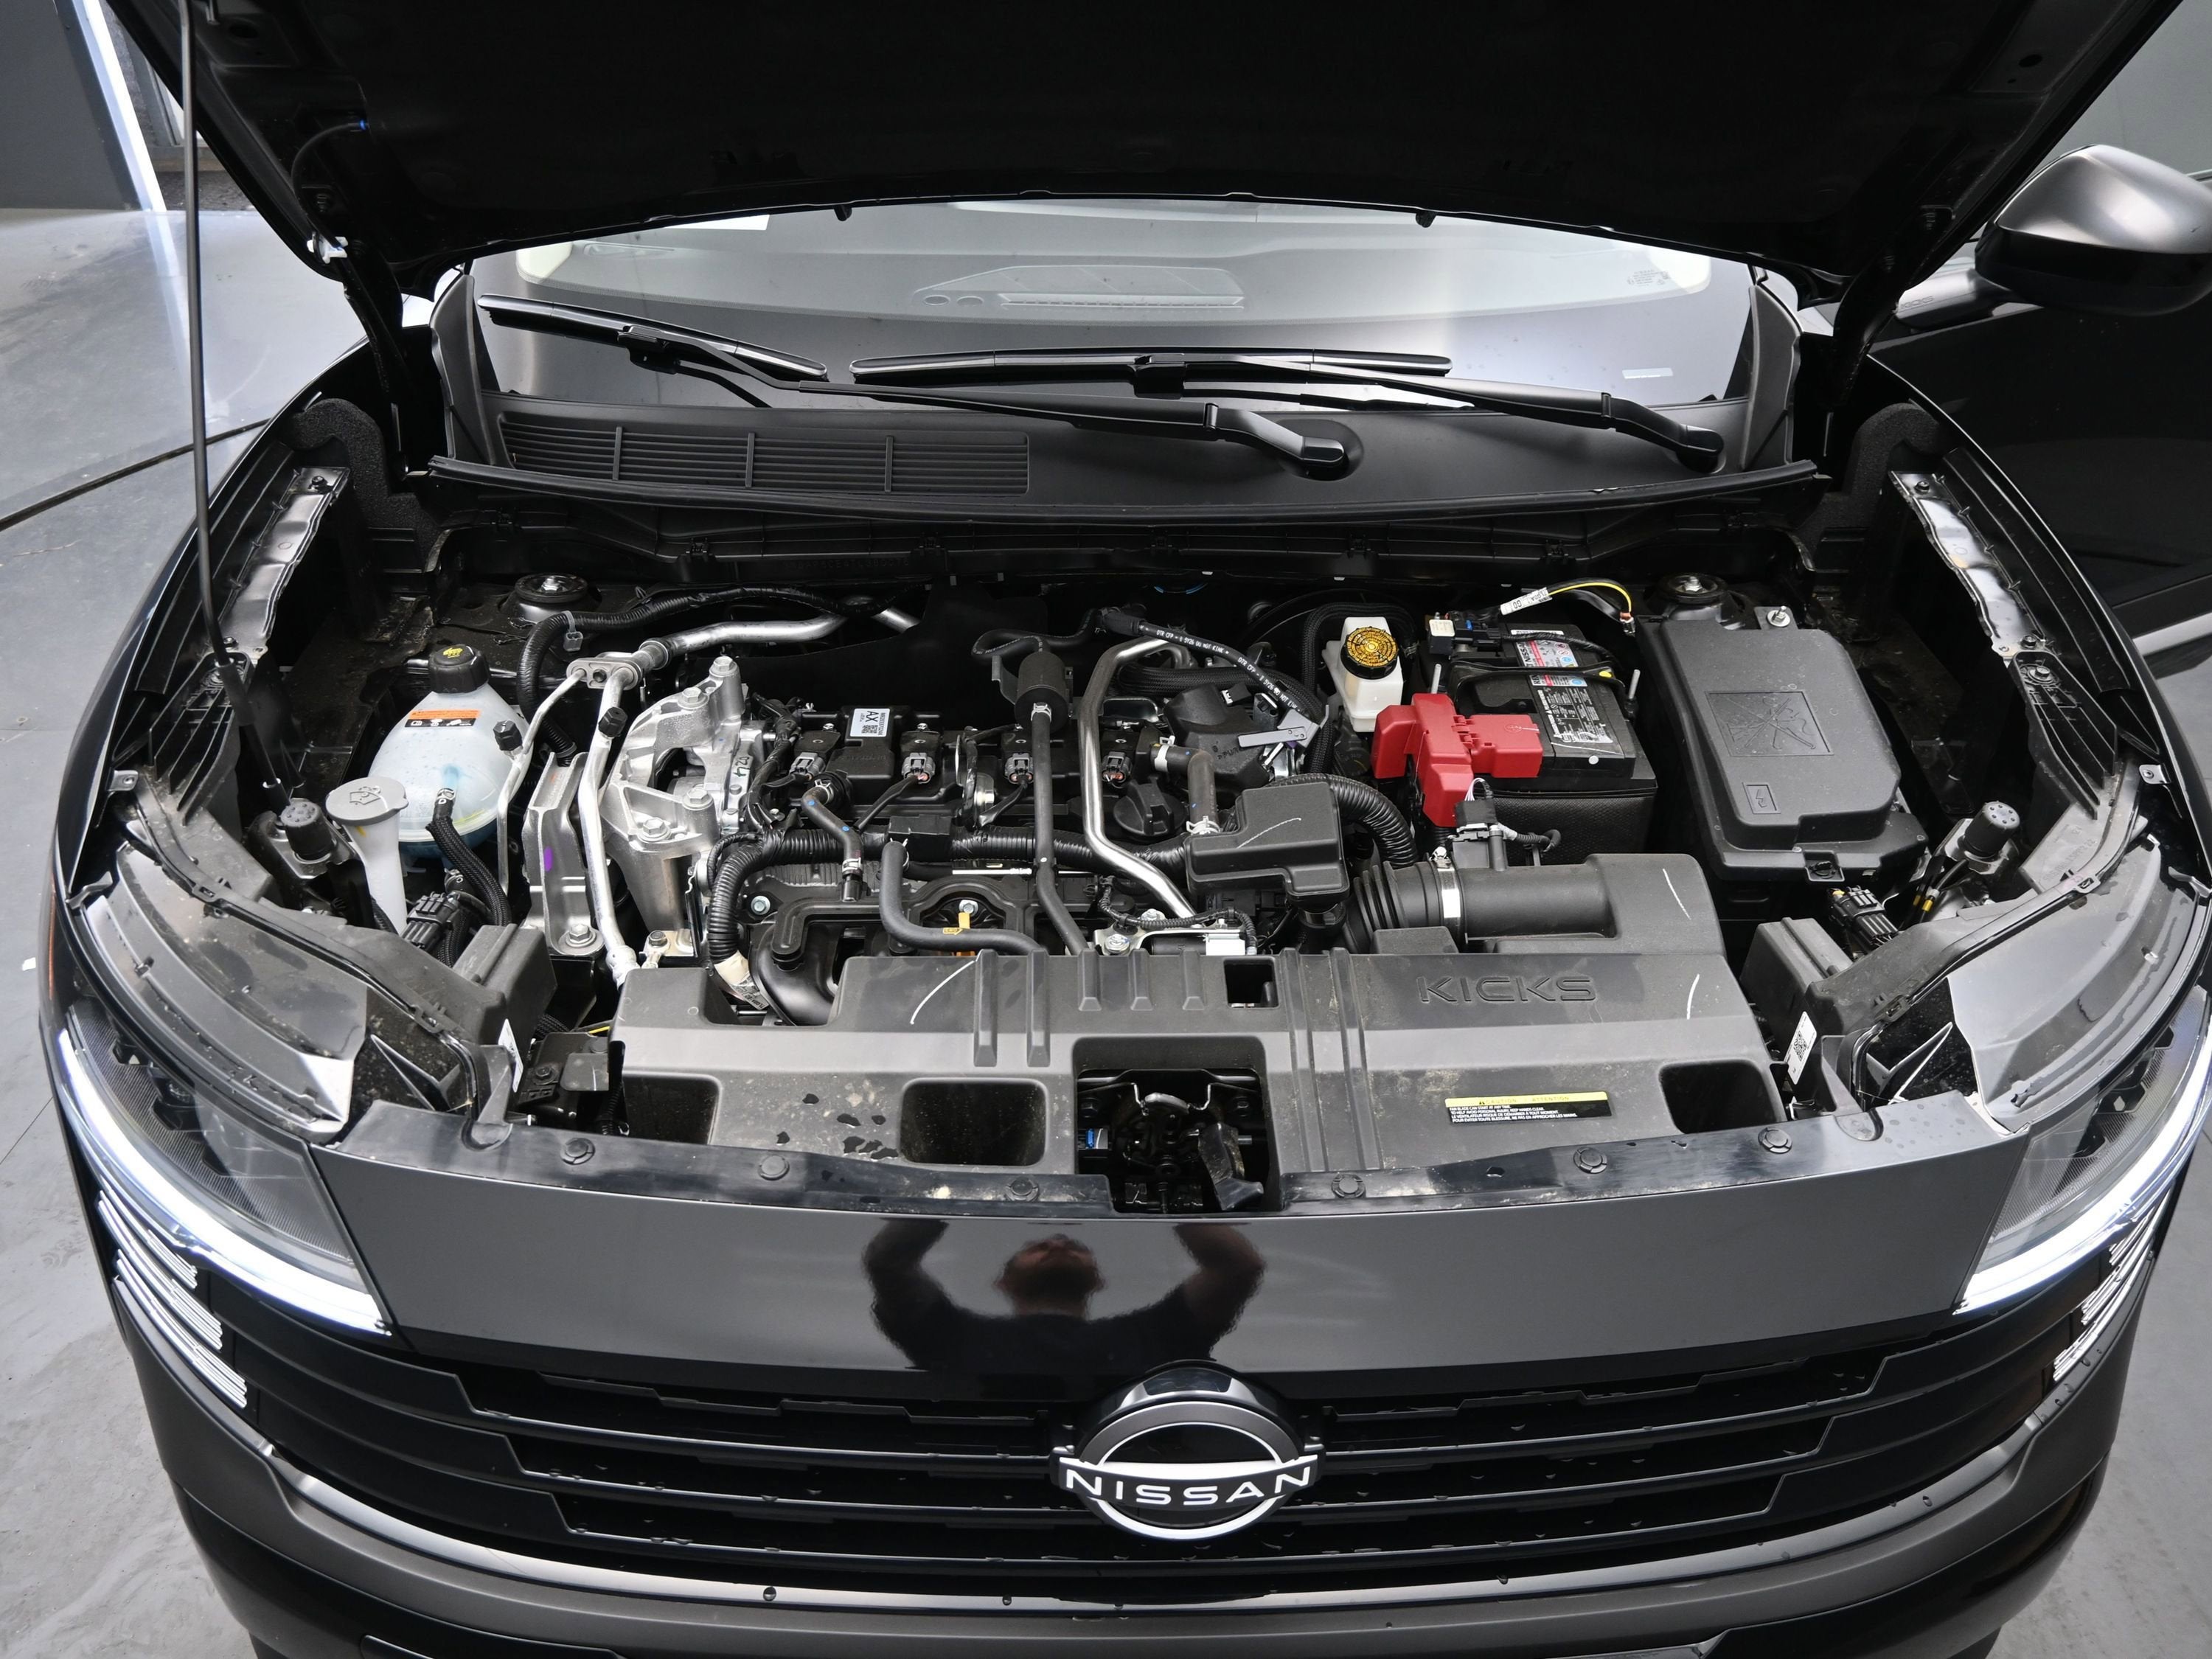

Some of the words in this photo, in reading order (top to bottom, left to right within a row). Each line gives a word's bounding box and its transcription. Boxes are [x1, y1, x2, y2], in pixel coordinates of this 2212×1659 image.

[1237, 656, 1248, 667] DTR
[865, 711, 879, 723] AX
[1416, 976, 1596, 1003] KICKS
[1066, 1467, 1310, 1506] NISSAN
